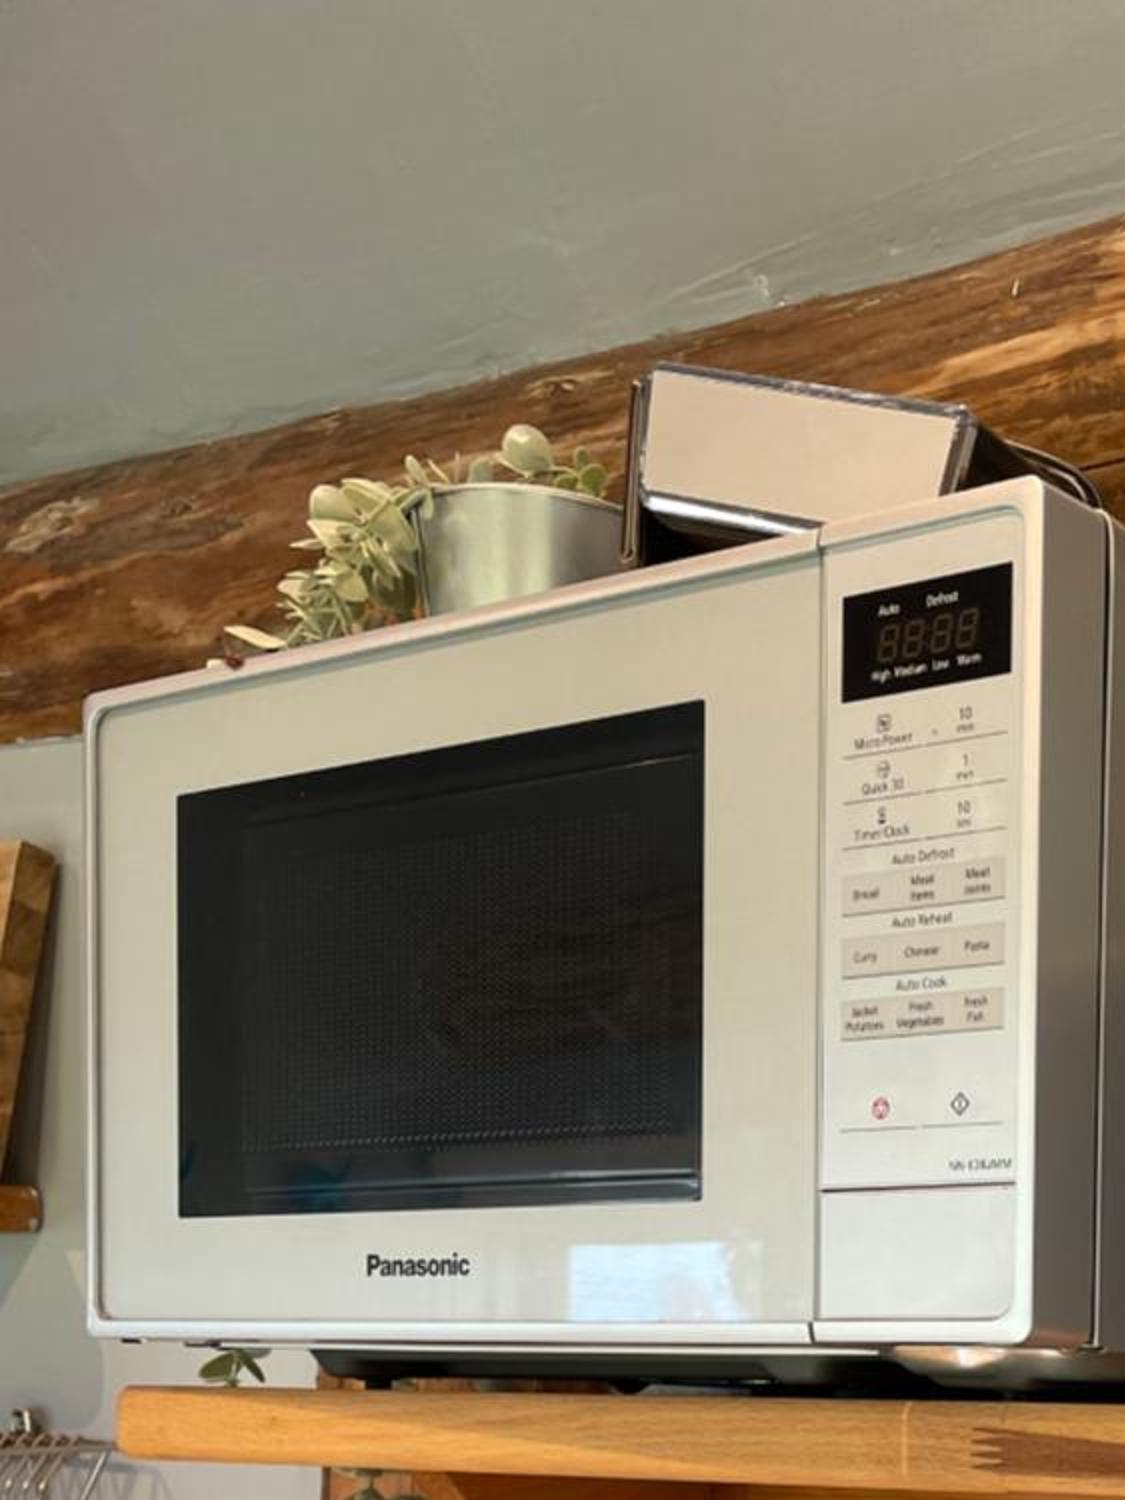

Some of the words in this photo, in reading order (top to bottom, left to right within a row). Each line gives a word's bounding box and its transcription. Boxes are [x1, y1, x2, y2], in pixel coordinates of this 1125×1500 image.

[926, 591, 960, 608] Defrost
[878, 604, 900, 618] Auto
[894, 664, 928, 678] Medium
[932, 659, 949, 671] Low
[959, 706, 973, 720] 10
[862, 781, 889, 796] Quick
[958, 800, 972, 815] 10
[892, 853, 916, 865] Auto
[918, 848, 955, 864] Defrost
[911, 874, 935, 886] Meat
[965, 867, 991, 880] Meat
[853, 888, 880, 900] Bread
[892, 916, 915, 928] Auto
[919, 912, 953, 926] Reheat
[904, 946, 941, 959] Chinese
[964, 940, 990, 952] Pasta
[853, 952, 878, 964] Curry
[896, 979, 921, 992] Auto
[923, 976, 947, 989] Cook
[908, 1001, 933, 1013] Fresh
[964, 995, 988, 1007] Fresh
[844, 1020, 884, 1032] Potatoes
[896, 1015, 945, 1029] Vegetables
[366, 1251, 471, 1277] Panasonic
